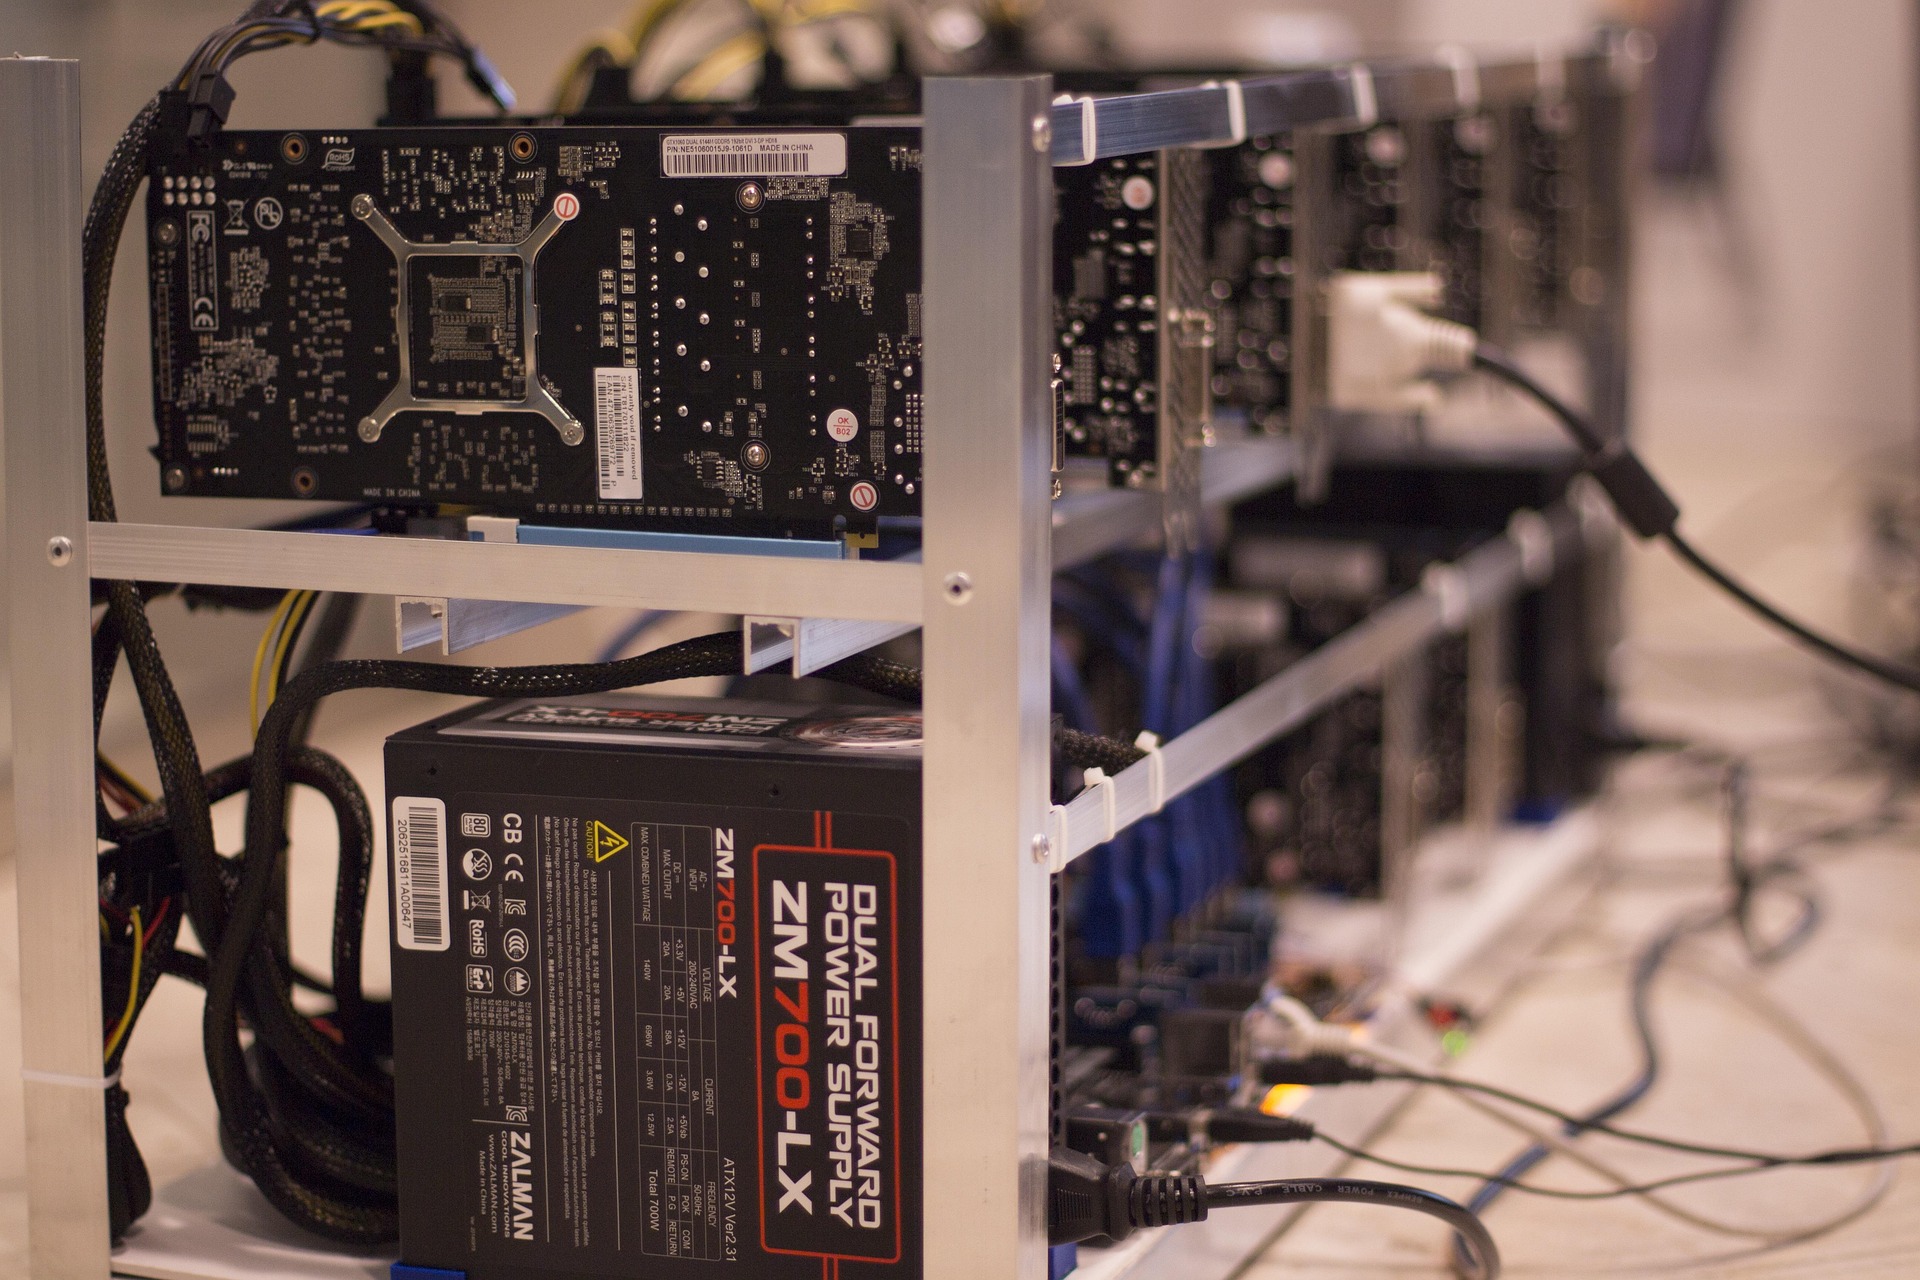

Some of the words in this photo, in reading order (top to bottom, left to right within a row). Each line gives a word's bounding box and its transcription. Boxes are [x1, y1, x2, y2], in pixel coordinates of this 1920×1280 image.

[836, 427, 850, 435] B02
[364, 488, 381, 496] MADE
[398, 489, 420, 497] CHINA
[473, 817, 486, 832] 80
[503, 813, 522, 844] CB
[585, 820, 594, 859] CAUTION!
[398, 819, 412, 929] 2062516811A00647
[572, 862, 580, 883] Risque
[641, 847, 650, 885] COMBINED
[663, 869, 672, 899] OUTPUT
[689, 869, 697, 891] INPUT
[642, 886, 651, 922] WATTAGE
[716, 827, 737, 998] ZM700-LX
[470, 920, 485, 954] RoHS
[554, 847, 562, 868] Riesgo
[558, 1007, 566, 1036] problema
[662, 941, 670, 956] 20A
[675, 938, 684, 962] +3.3V
[853, 883, 878, 1000] DUAL
[643, 959, 651, 981] 140W
[824, 882, 851, 1047] POWER
[663, 985, 671, 1000] 20A
[676, 986, 684, 1002] +5V
[688, 960, 697, 1009] 200-240VAC
[702, 967, 711, 1002] VOLTAGE
[645, 1025, 653, 1047] 696W
[665, 1030, 673, 1045] 58A
[678, 1029, 686, 1049] +12V
[772, 879, 813, 1216] ZM700-LX
[646, 1070, 654, 1090] 3.6W
[666, 1073, 674, 1091] 0.3A
[679, 1074, 687, 1092] -12V
[692, 1090, 700, 1101] 8A
[705, 1078, 714, 1116] CURRENT
[647, 1113, 655, 1136] 12.5W
[667, 1117, 675, 1134] 2.5A
[680, 1114, 688, 1138] +5Vsb
[854, 1014, 881, 1229] FORWARD
[827, 1063, 854, 1228] SUPPLY
[667, 1148, 676, 1183] REMOTE
[681, 1154, 689, 1181] PS-ON
[480, 1178, 487, 1186] in
[489, 1134, 498, 1233] www.ZALMAN.com
[510, 1131, 534, 1241] ZALMAN
[648, 1170, 659, 1196] Total
[723, 1157, 736, 1210] ATX12V
[1282, 1184, 1322, 1193] CABLE
[1337, 1185, 1374, 1196] POWER
[480, 1189, 488, 1215] China
[502, 1165, 510, 1238] INNOVATIONS
[682, 1195, 690, 1213] POK
[694, 1184, 702, 1216] 50-60Hz
[707, 1182, 716, 1227] FREQUENCY
[650, 1199, 660, 1231] 700W
[669, 1221, 677, 1255] RETURN
[682, 1229, 691, 1249] COM
[725, 1214, 737, 1262] Ver2.31
